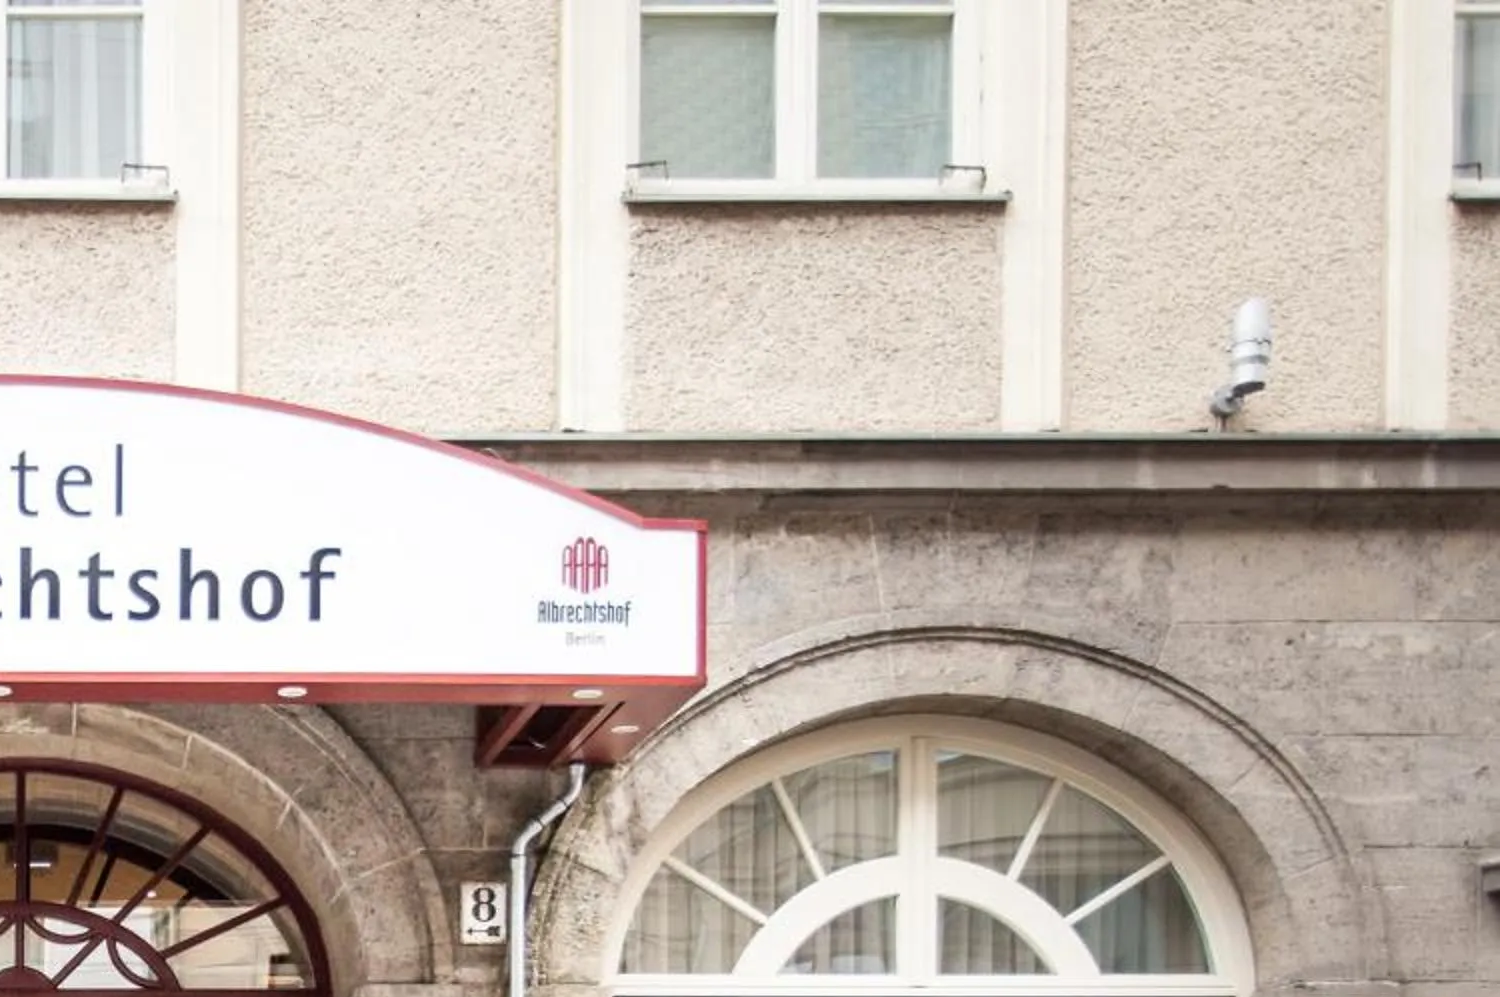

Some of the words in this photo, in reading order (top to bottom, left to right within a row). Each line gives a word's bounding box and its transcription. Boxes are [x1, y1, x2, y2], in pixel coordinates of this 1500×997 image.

[537, 600, 632, 627] Albrechtshof
[565, 631, 606, 646] Berlin
[472, 887, 497, 921] 8
